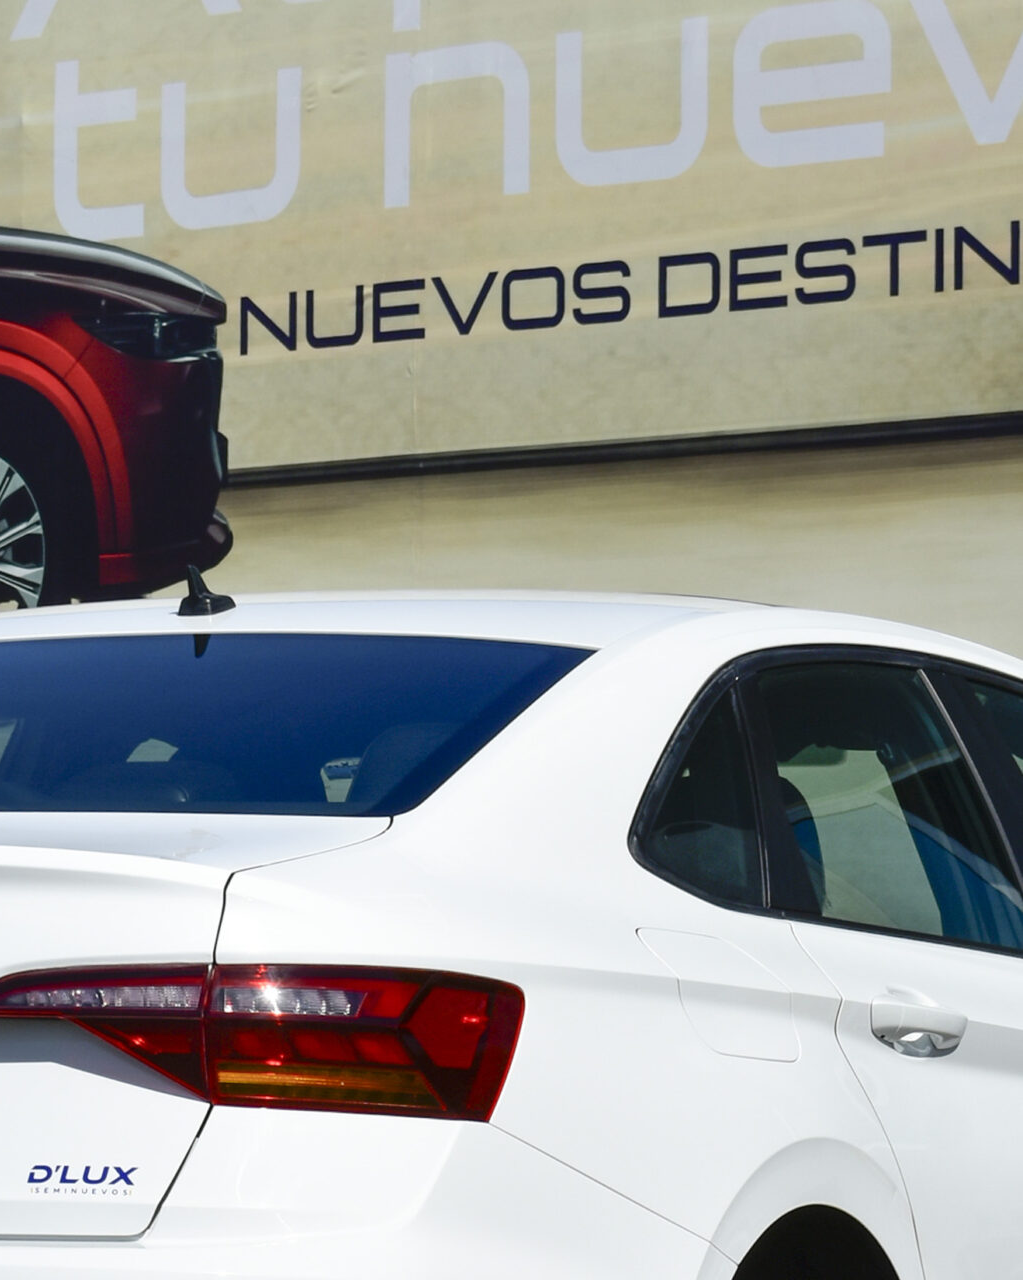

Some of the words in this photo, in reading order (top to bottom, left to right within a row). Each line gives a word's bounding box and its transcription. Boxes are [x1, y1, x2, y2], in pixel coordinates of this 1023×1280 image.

[53, 59, 303, 240] tu
[239, 260, 632, 357] NUEVOS
[658, 219, 1023, 319] DESTIN
[27, 1164, 139, 1186] D'LUX
